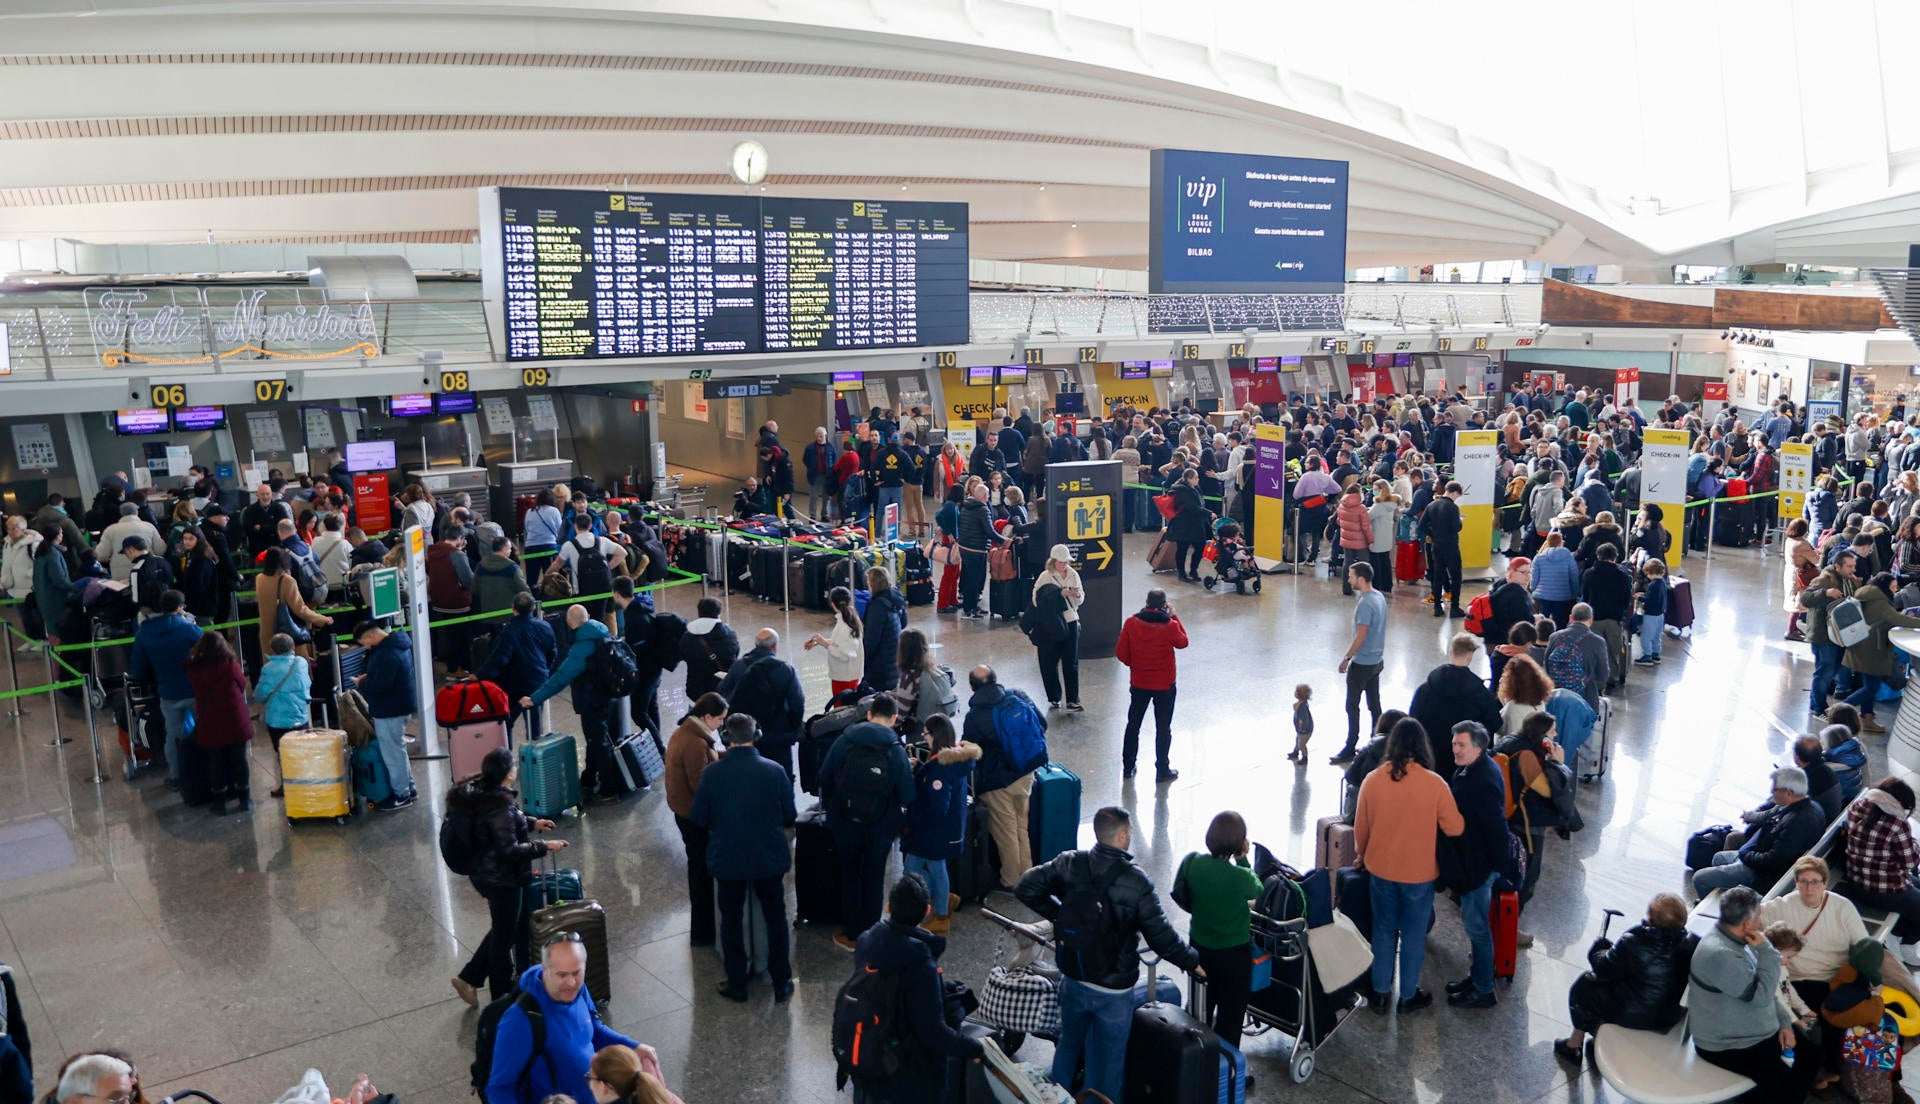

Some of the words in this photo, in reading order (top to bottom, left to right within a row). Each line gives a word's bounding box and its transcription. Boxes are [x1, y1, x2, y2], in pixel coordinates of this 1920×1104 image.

[1186, 176, 1217, 207] vip
[1249, 199, 1262, 209] Enjoy
[1187, 248, 1213, 256] BILBAO
[1231, 344, 1244, 358] 14
[1335, 342, 1347, 354] 15
[1362, 342, 1374, 353] 16
[1439, 338, 1451, 351] 17
[1475, 338, 1486, 350] 18
[1026, 350, 1042, 364] 11
[1080, 348, 1096, 362] 12
[1184, 346, 1198, 359] 13
[938, 353, 956, 367] 10
[442, 372, 468, 392] 08
[523, 368, 548, 387] 09
[152, 385, 185, 406] 06
[256, 380, 286, 401] 07
[953, 402, 1008, 414] CHECK-
